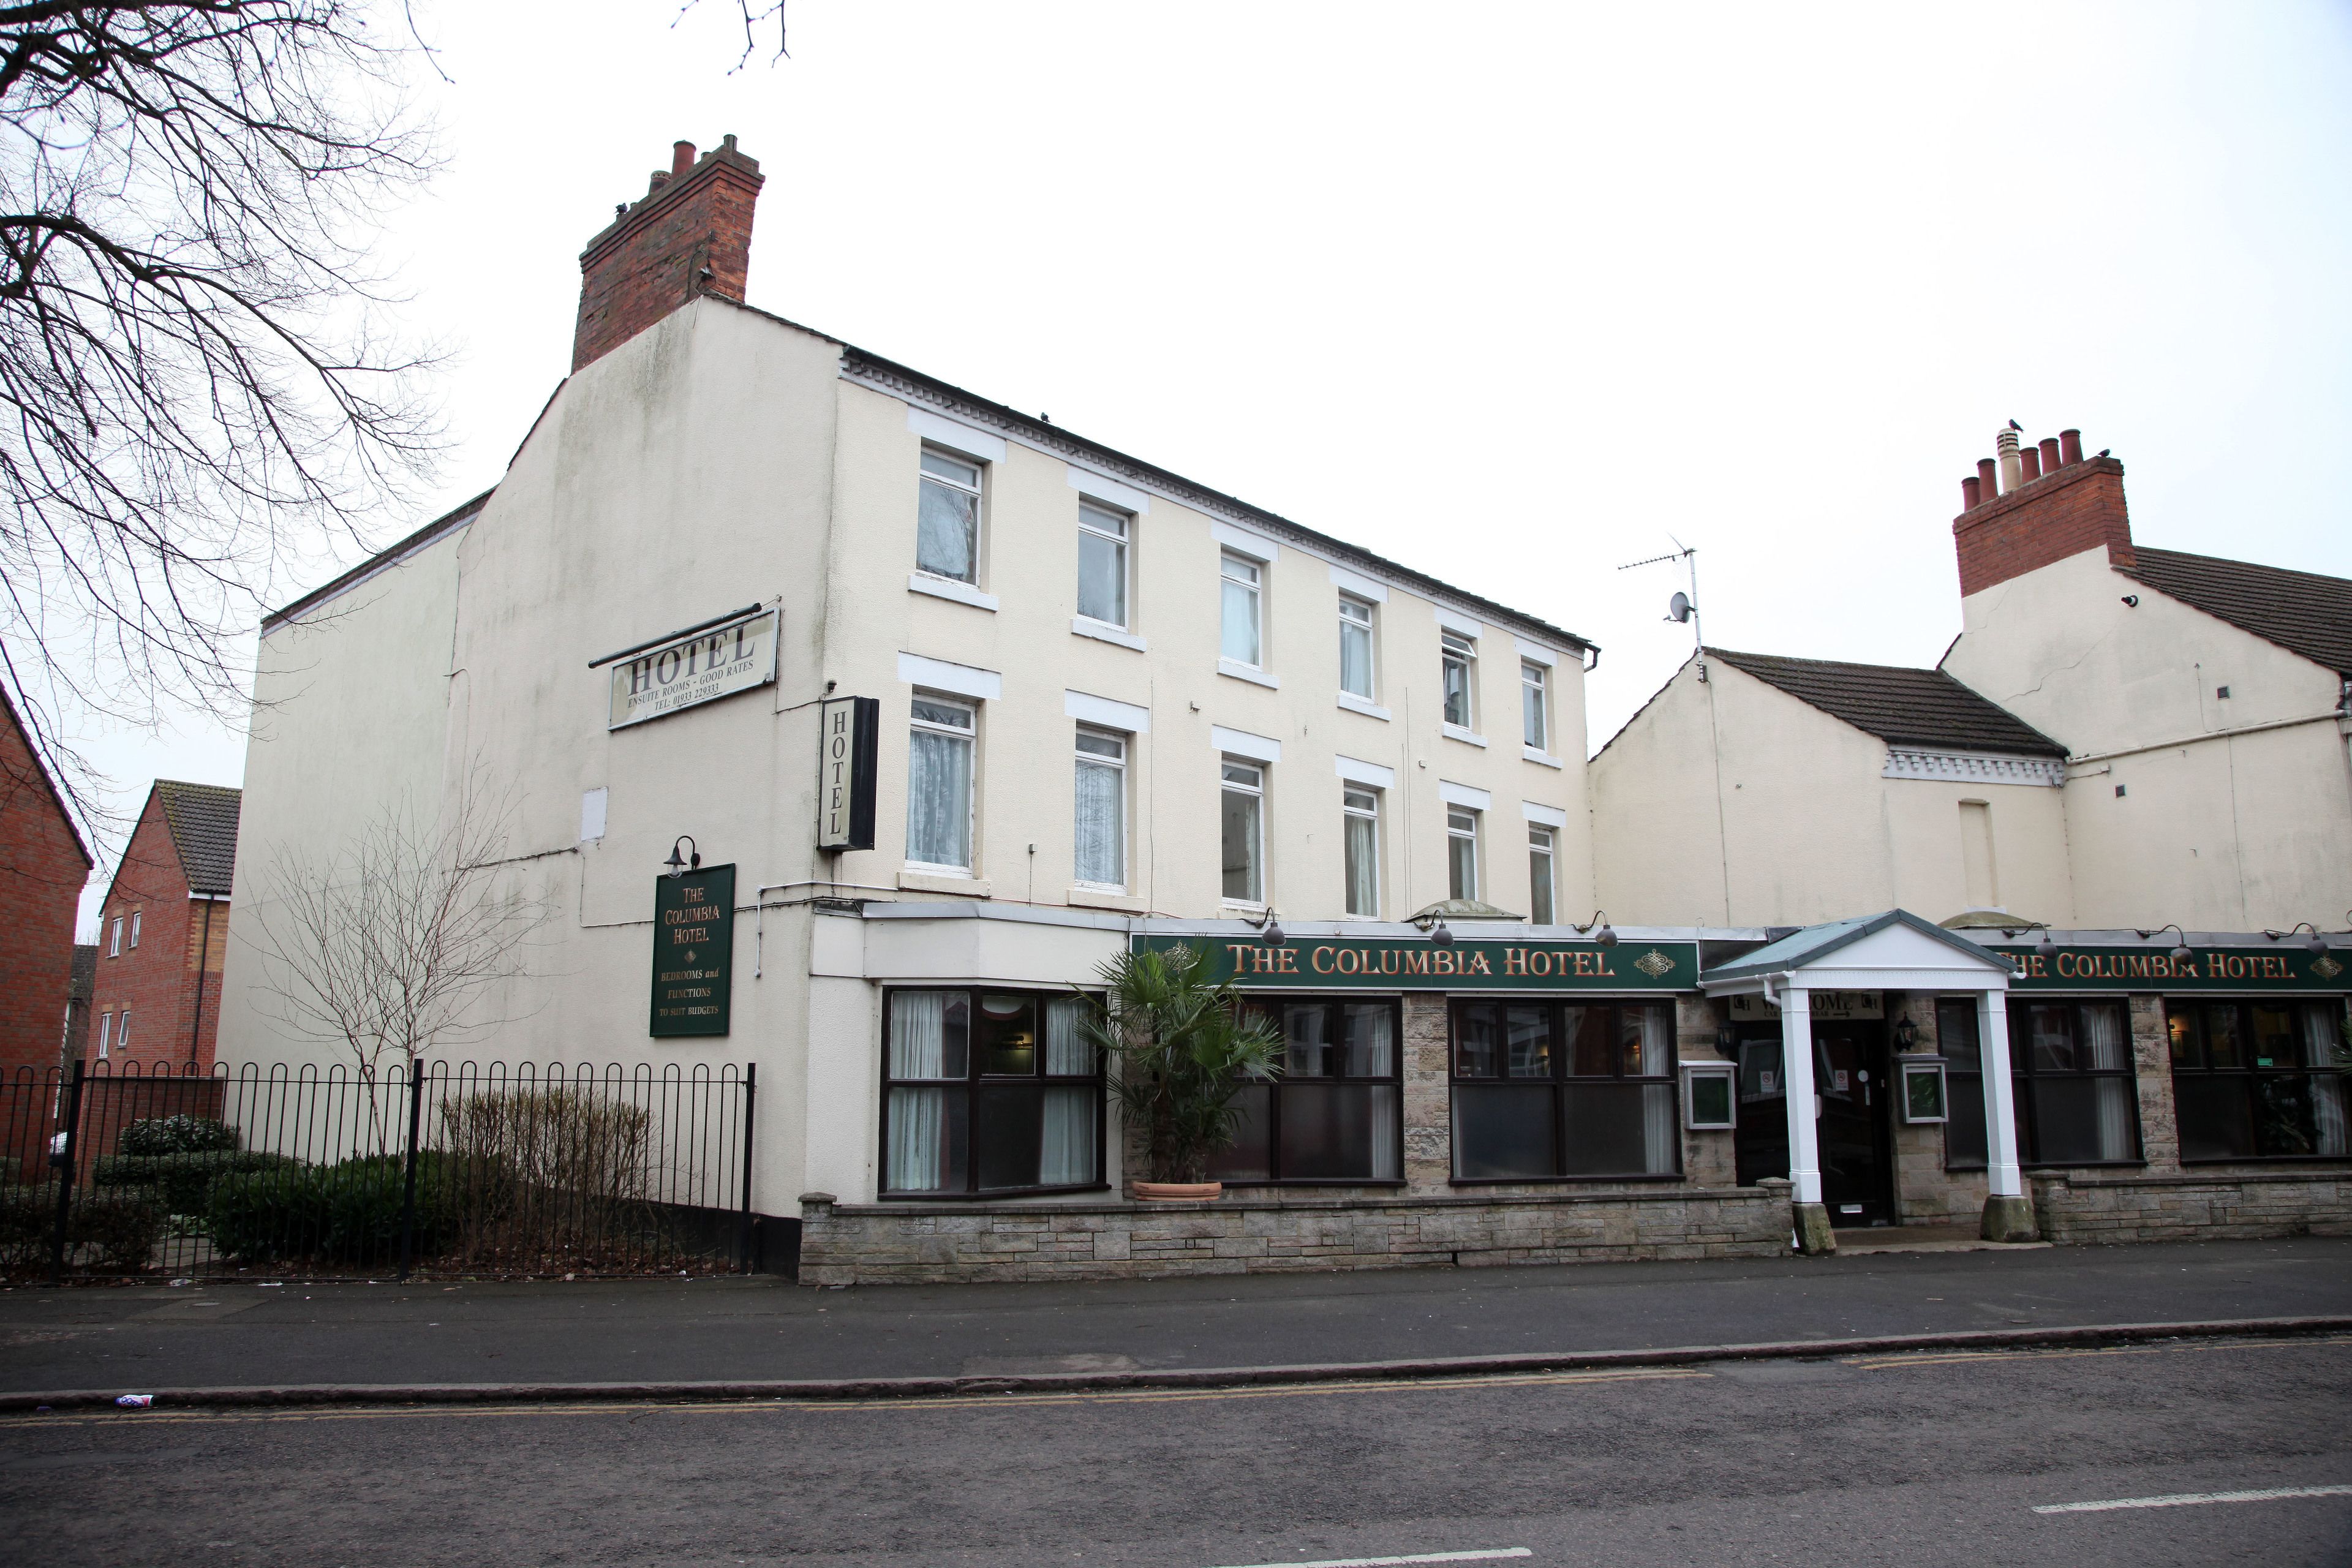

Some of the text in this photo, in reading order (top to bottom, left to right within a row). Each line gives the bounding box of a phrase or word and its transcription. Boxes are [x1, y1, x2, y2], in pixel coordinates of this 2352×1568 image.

[628, 624, 755, 696] HOTEL
[628, 690, 660, 708] ENSUITE
[663, 680, 690, 696] ROOMS
[700, 669, 723, 684] GOOD
[726, 660, 754, 677] RATES
[655, 683, 719, 710] TEL: 01933 229333
[829, 710, 847, 835] HOTEL
[683, 888, 704, 903] THE
[665, 905, 720, 925] COLUMBIA
[674, 927, 709, 944] HOTEL
[1225, 944, 1615, 976] THE COLUMBIA HOTEL
[2207, 953, 2296, 978] HOTEL
[661, 967, 720, 981] BEDROOMS and
[668, 987, 711, 999] FUNCTIONS
[670, 1007, 686, 1016] SUIT
[688, 1006, 718, 1015] BUDGETS
